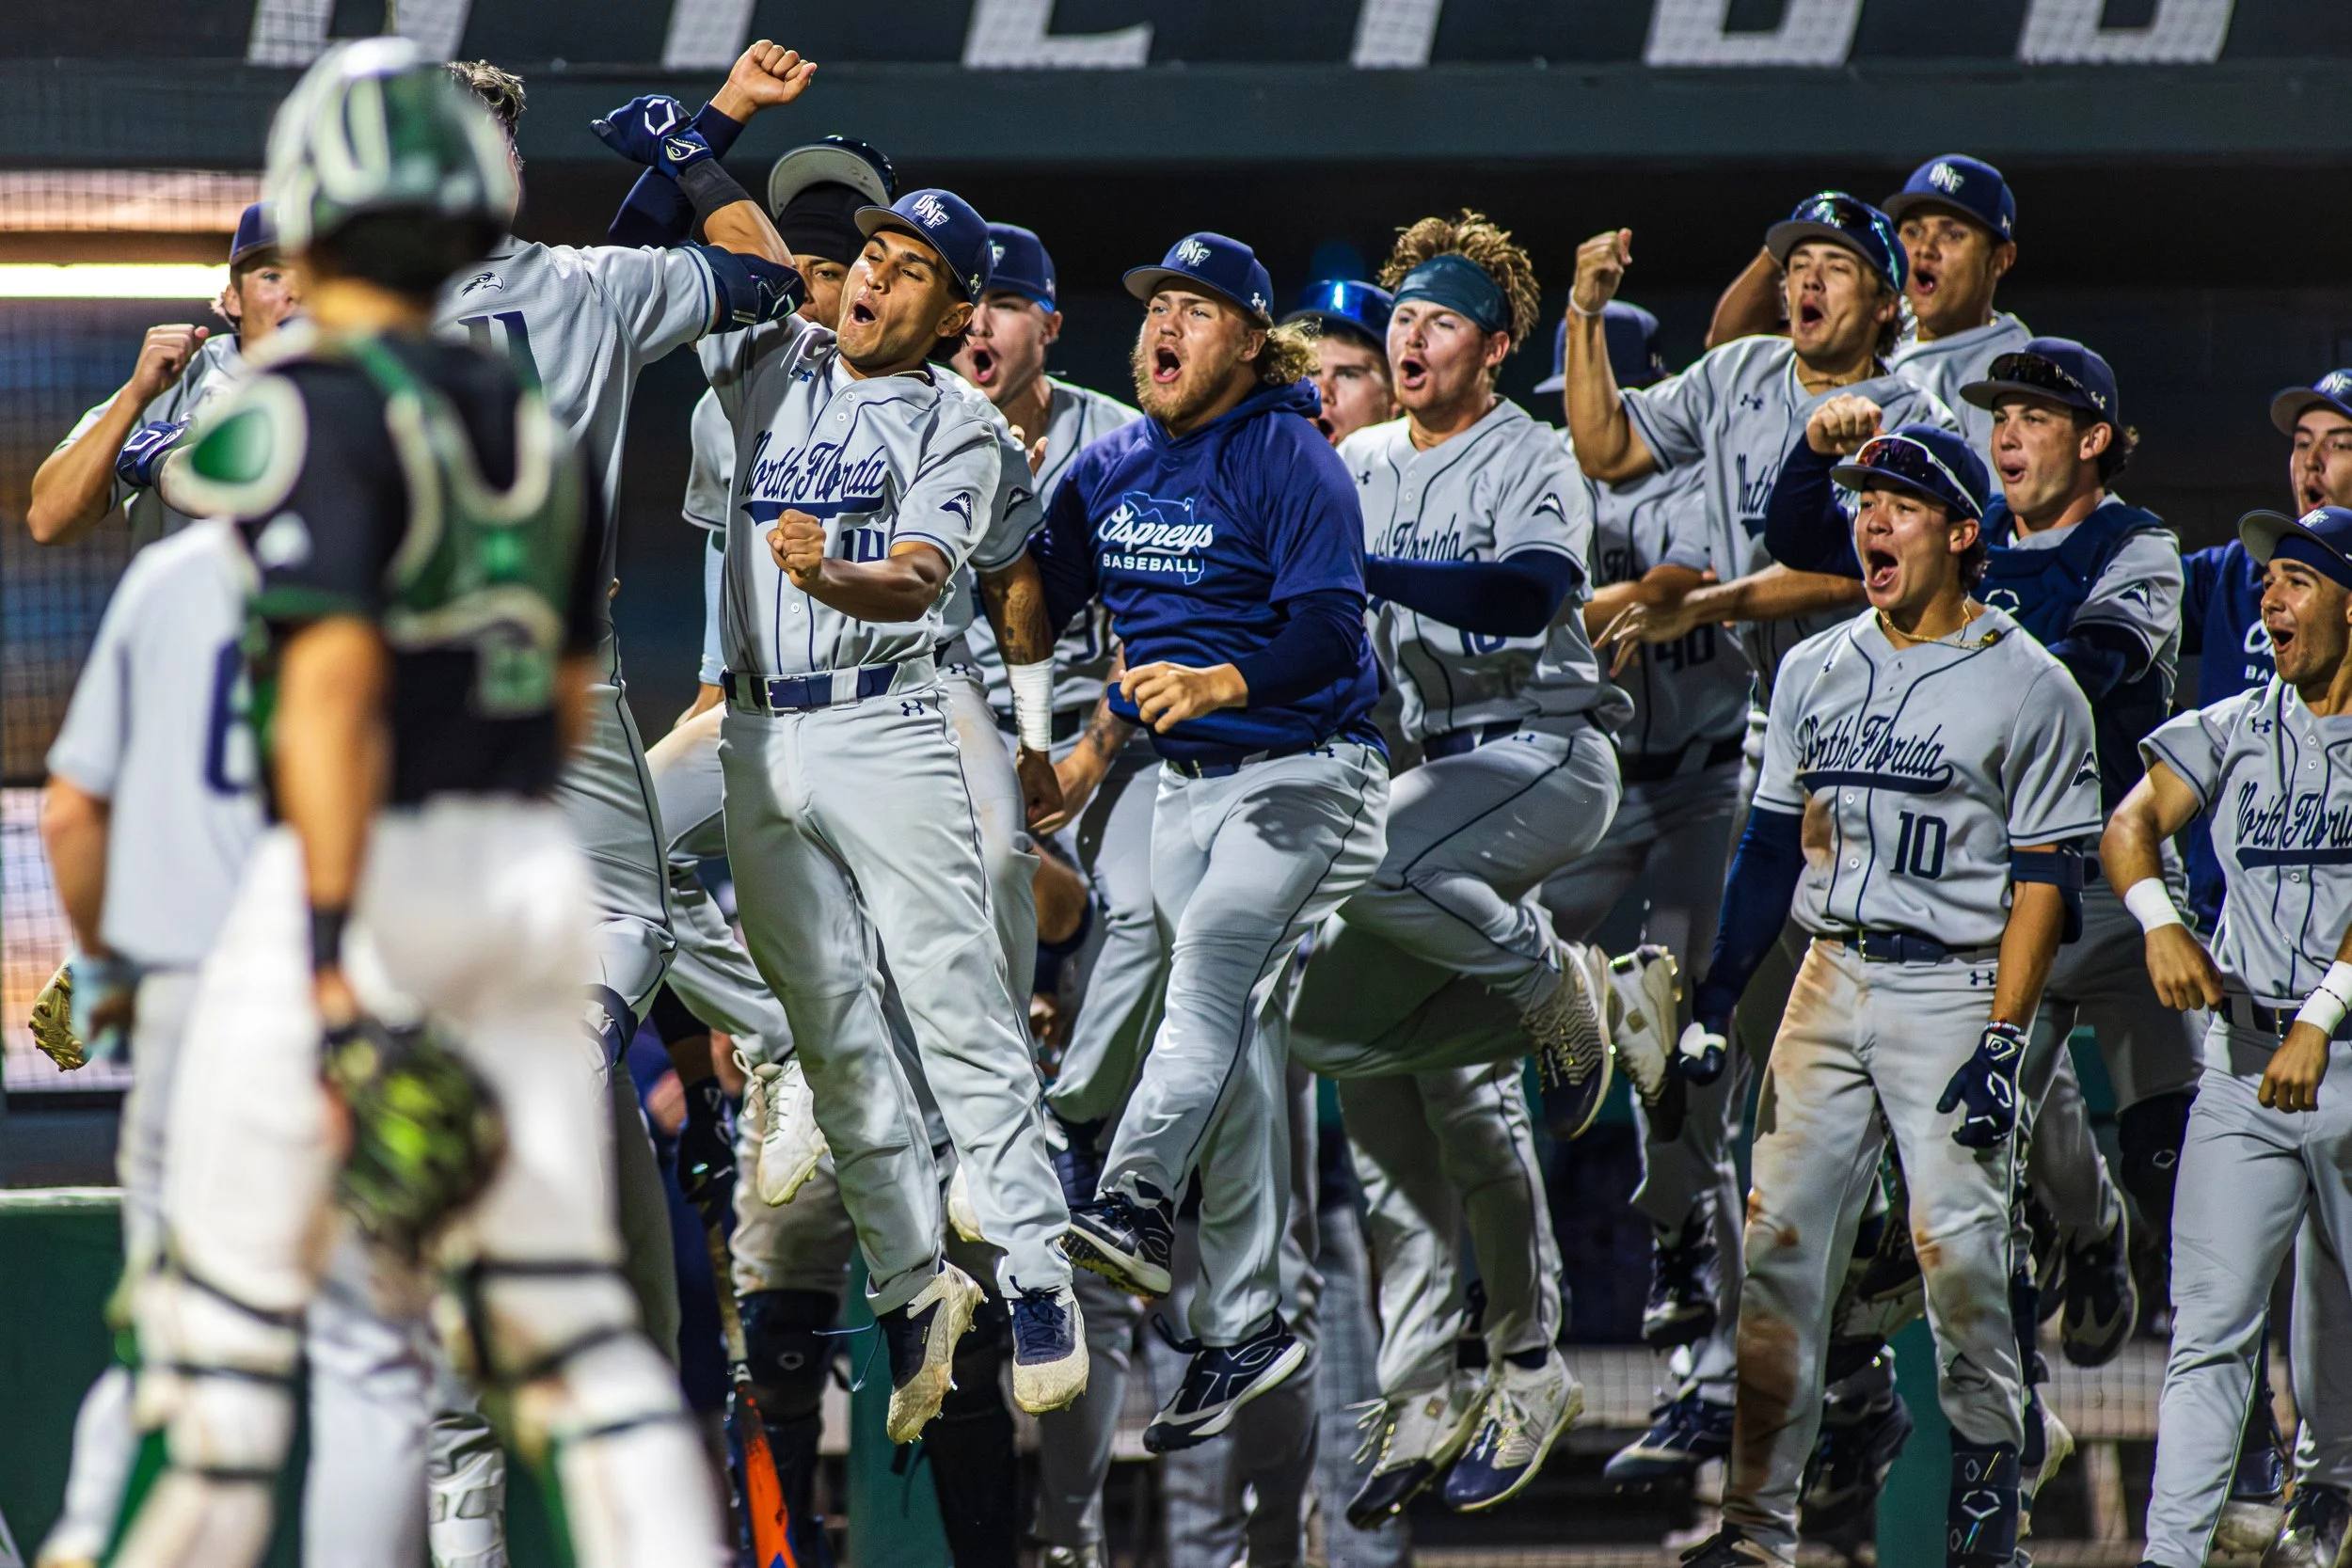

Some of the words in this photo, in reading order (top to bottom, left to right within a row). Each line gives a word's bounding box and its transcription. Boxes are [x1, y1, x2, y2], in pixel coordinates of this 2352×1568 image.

[912, 194, 950, 230] UNF
[1176, 238, 1212, 268] UNF
[739, 430, 805, 499] North
[1098, 503, 1213, 556] Ospreys
[1103, 553, 1199, 572] BASEBALL
[1848, 715, 1945, 778] Florida
[1890, 811, 1947, 879] 10
